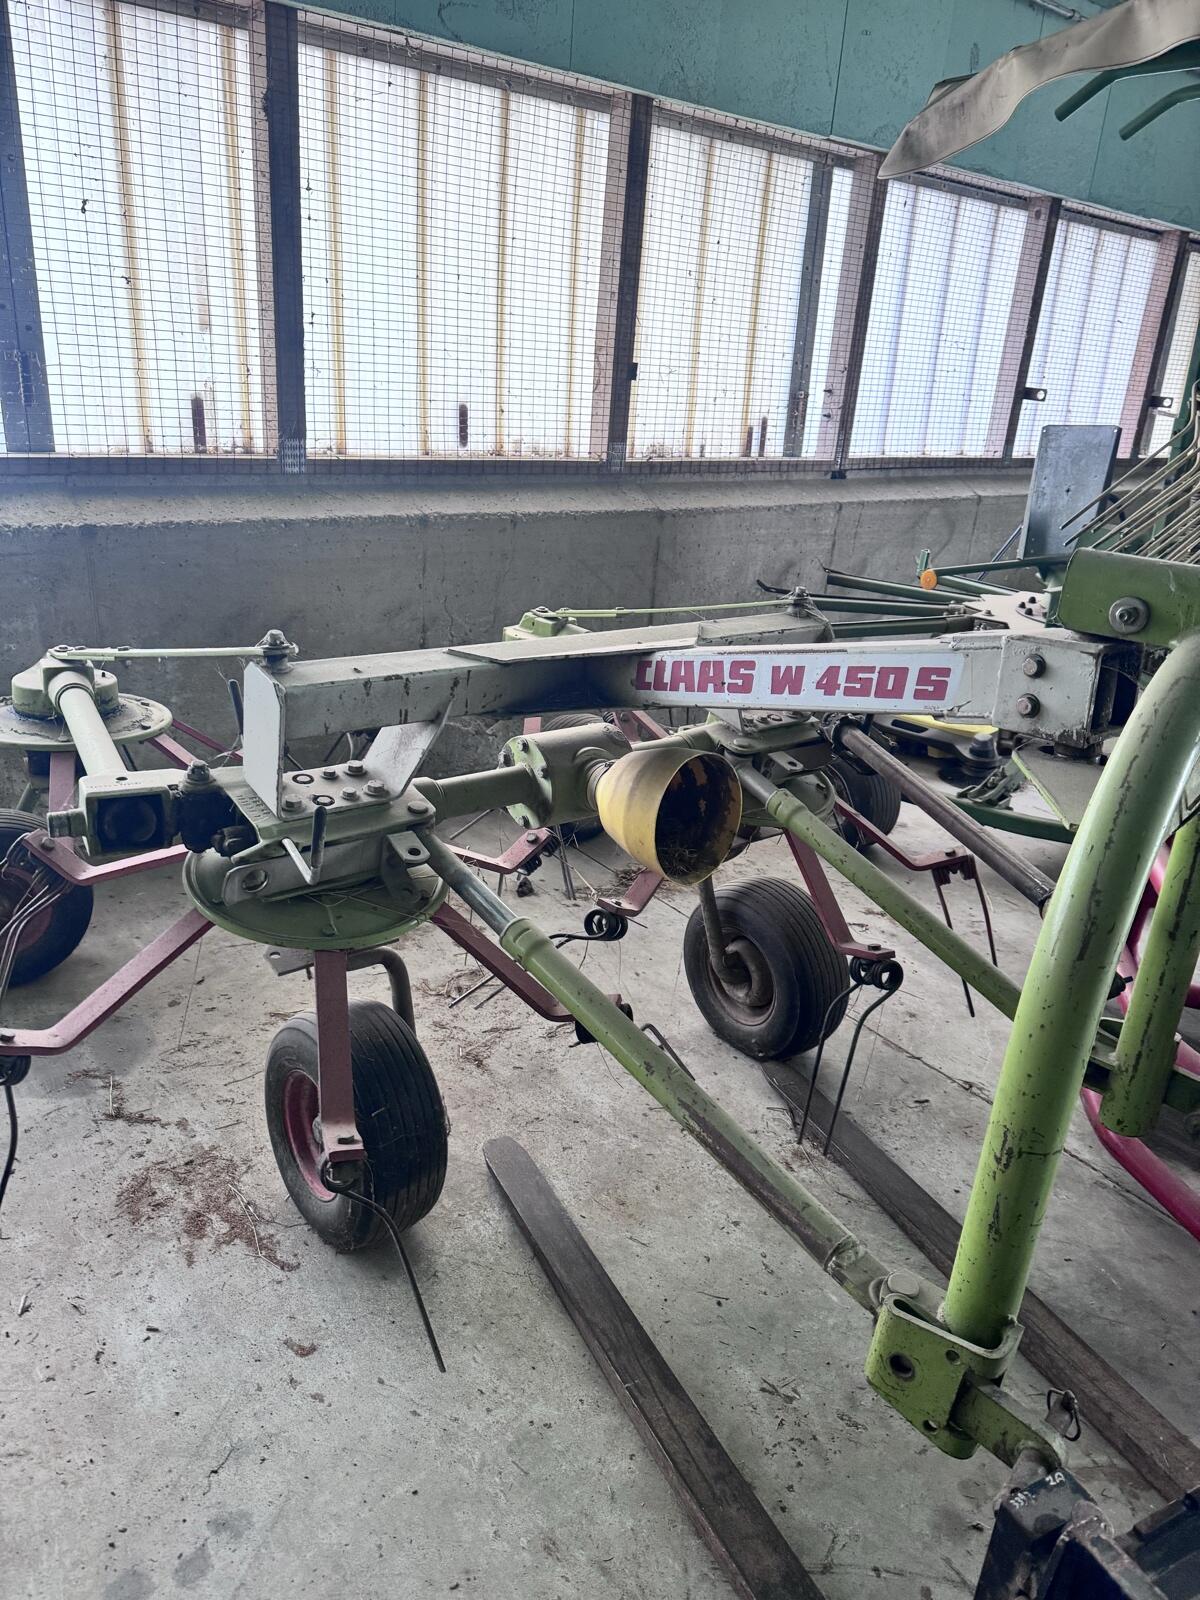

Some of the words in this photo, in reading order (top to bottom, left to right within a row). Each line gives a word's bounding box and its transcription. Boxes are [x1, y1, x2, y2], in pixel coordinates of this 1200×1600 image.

[635, 660, 756, 694] CLAAS
[770, 666, 805, 695] W
[815, 665, 909, 699] 450
[913, 667, 951, 700] S
